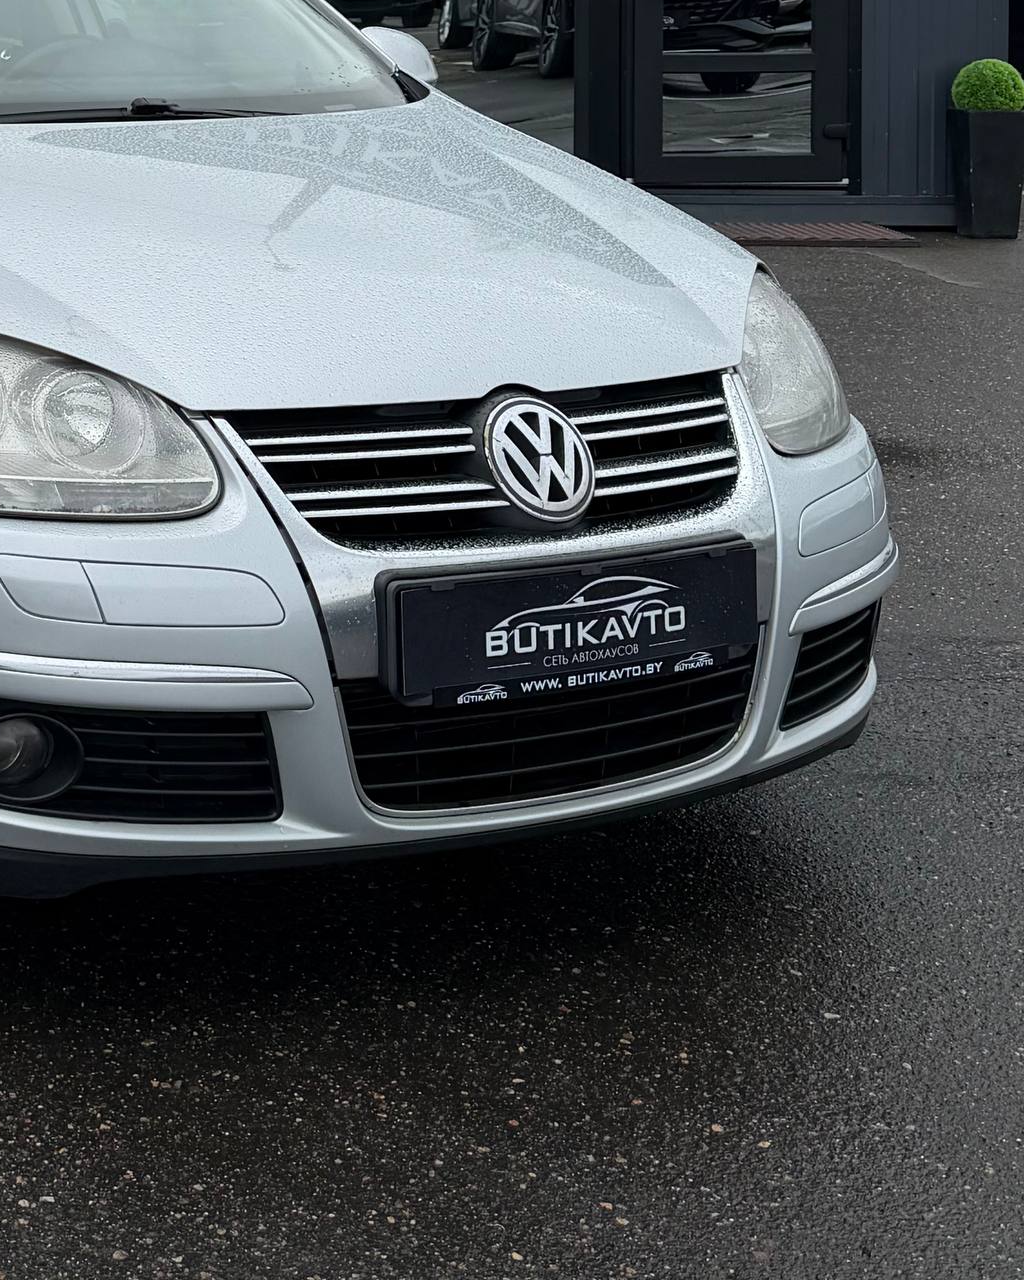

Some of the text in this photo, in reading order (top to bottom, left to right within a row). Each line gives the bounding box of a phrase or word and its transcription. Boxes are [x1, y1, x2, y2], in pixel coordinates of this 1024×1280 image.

[485, 605, 686, 658] BUTIKAVTO
[543, 643, 640, 668] СЕТЬ АВТОХАУСОВ
[674, 658, 714, 673] BUTIKAVTO
[520, 661, 664, 693] WWW. BUTIKAVTO.BY
[456, 691, 508, 705] BUTIKAVTO
